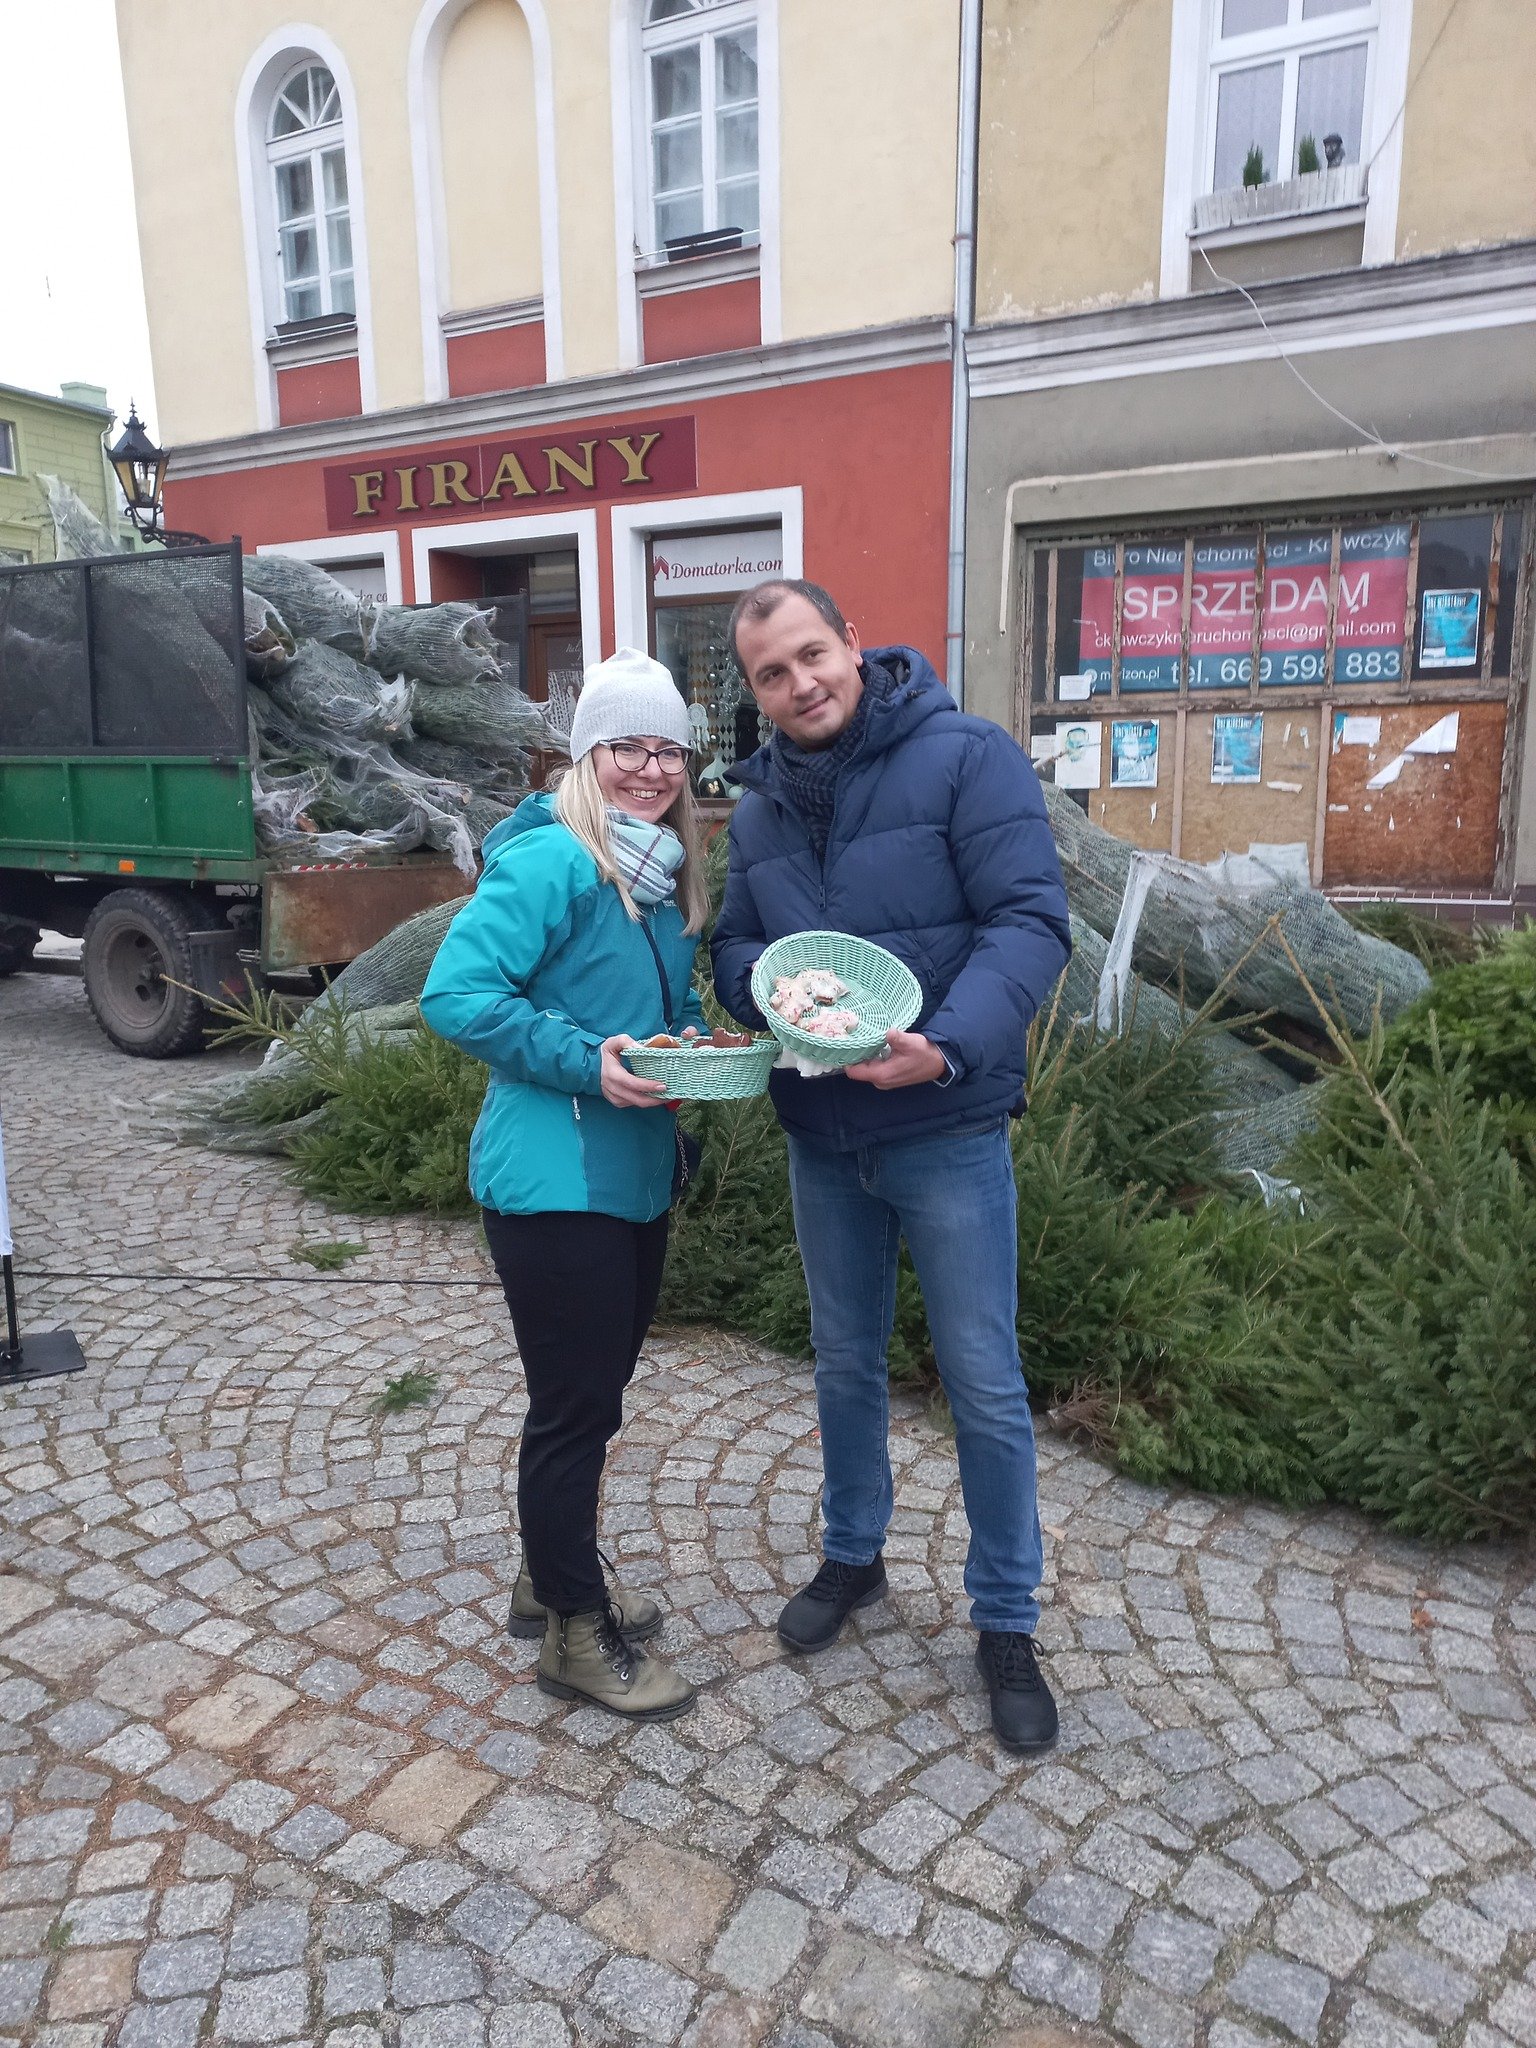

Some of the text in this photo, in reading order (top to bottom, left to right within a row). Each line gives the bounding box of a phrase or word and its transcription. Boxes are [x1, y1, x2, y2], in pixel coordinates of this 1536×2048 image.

[349, 432, 661, 517] FIRANY
[1094, 549, 1140, 567] Bio
[1308, 528, 1407, 554] Krwczyk
[1123, 572, 1370, 621] SPRZEDAM
[1100, 666, 1160, 682] mizon.pl
[1220, 656, 1272, 683] 669
[1345, 650, 1400, 678] 883
